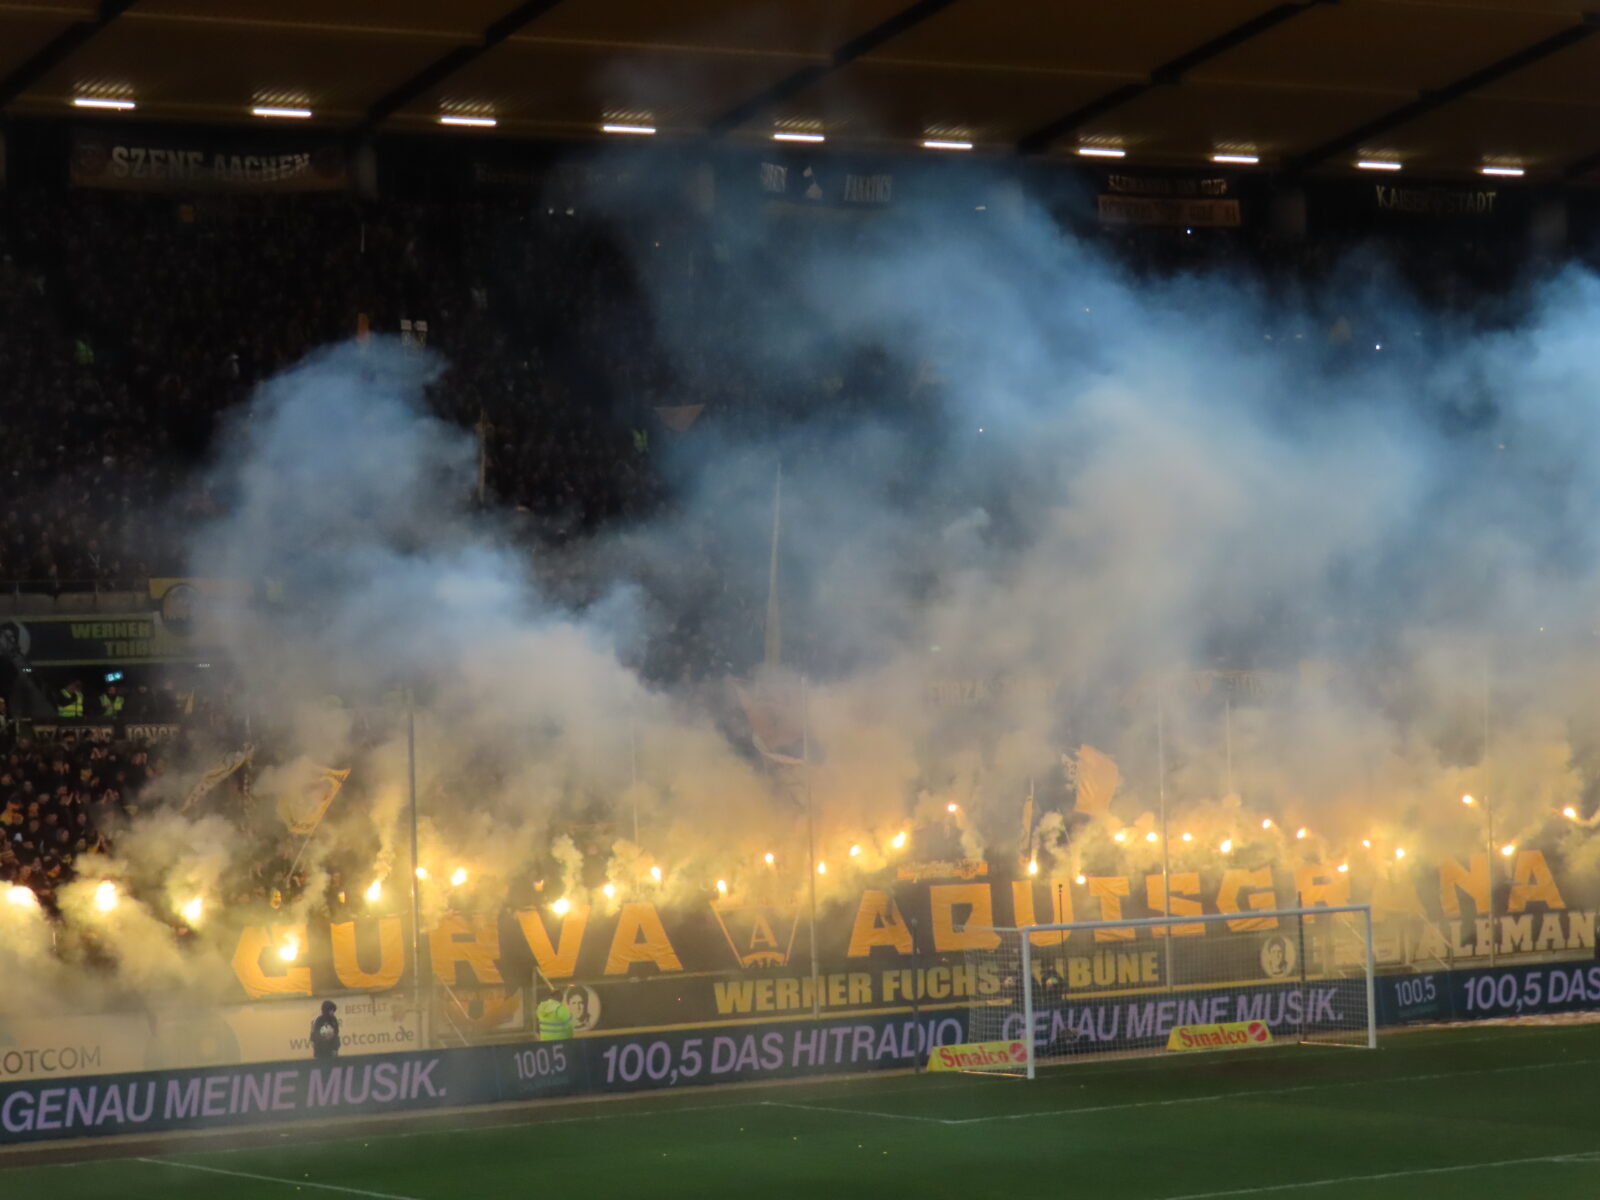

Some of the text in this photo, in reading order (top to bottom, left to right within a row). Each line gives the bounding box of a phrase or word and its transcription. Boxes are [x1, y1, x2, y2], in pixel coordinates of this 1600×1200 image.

[111, 145, 204, 180] SZENE
[231, 900, 684, 998] CURVA
[714, 973, 873, 1014] WERNER
[1462, 966, 1600, 1014] 100,5 DAS
[1125, 993, 1231, 1040] MEINE
[1236, 986, 1344, 1027] MUSIK.
[602, 1017, 964, 1085] 100,5 DAS HITRADIO
[938, 1044, 1009, 1069] Sinalco
[1179, 1025, 1249, 1049] Sinalco
[0, 1046, 101, 1076] OTCOM
[2, 1058, 448, 1133] GENAU MEINE MUSIK.
